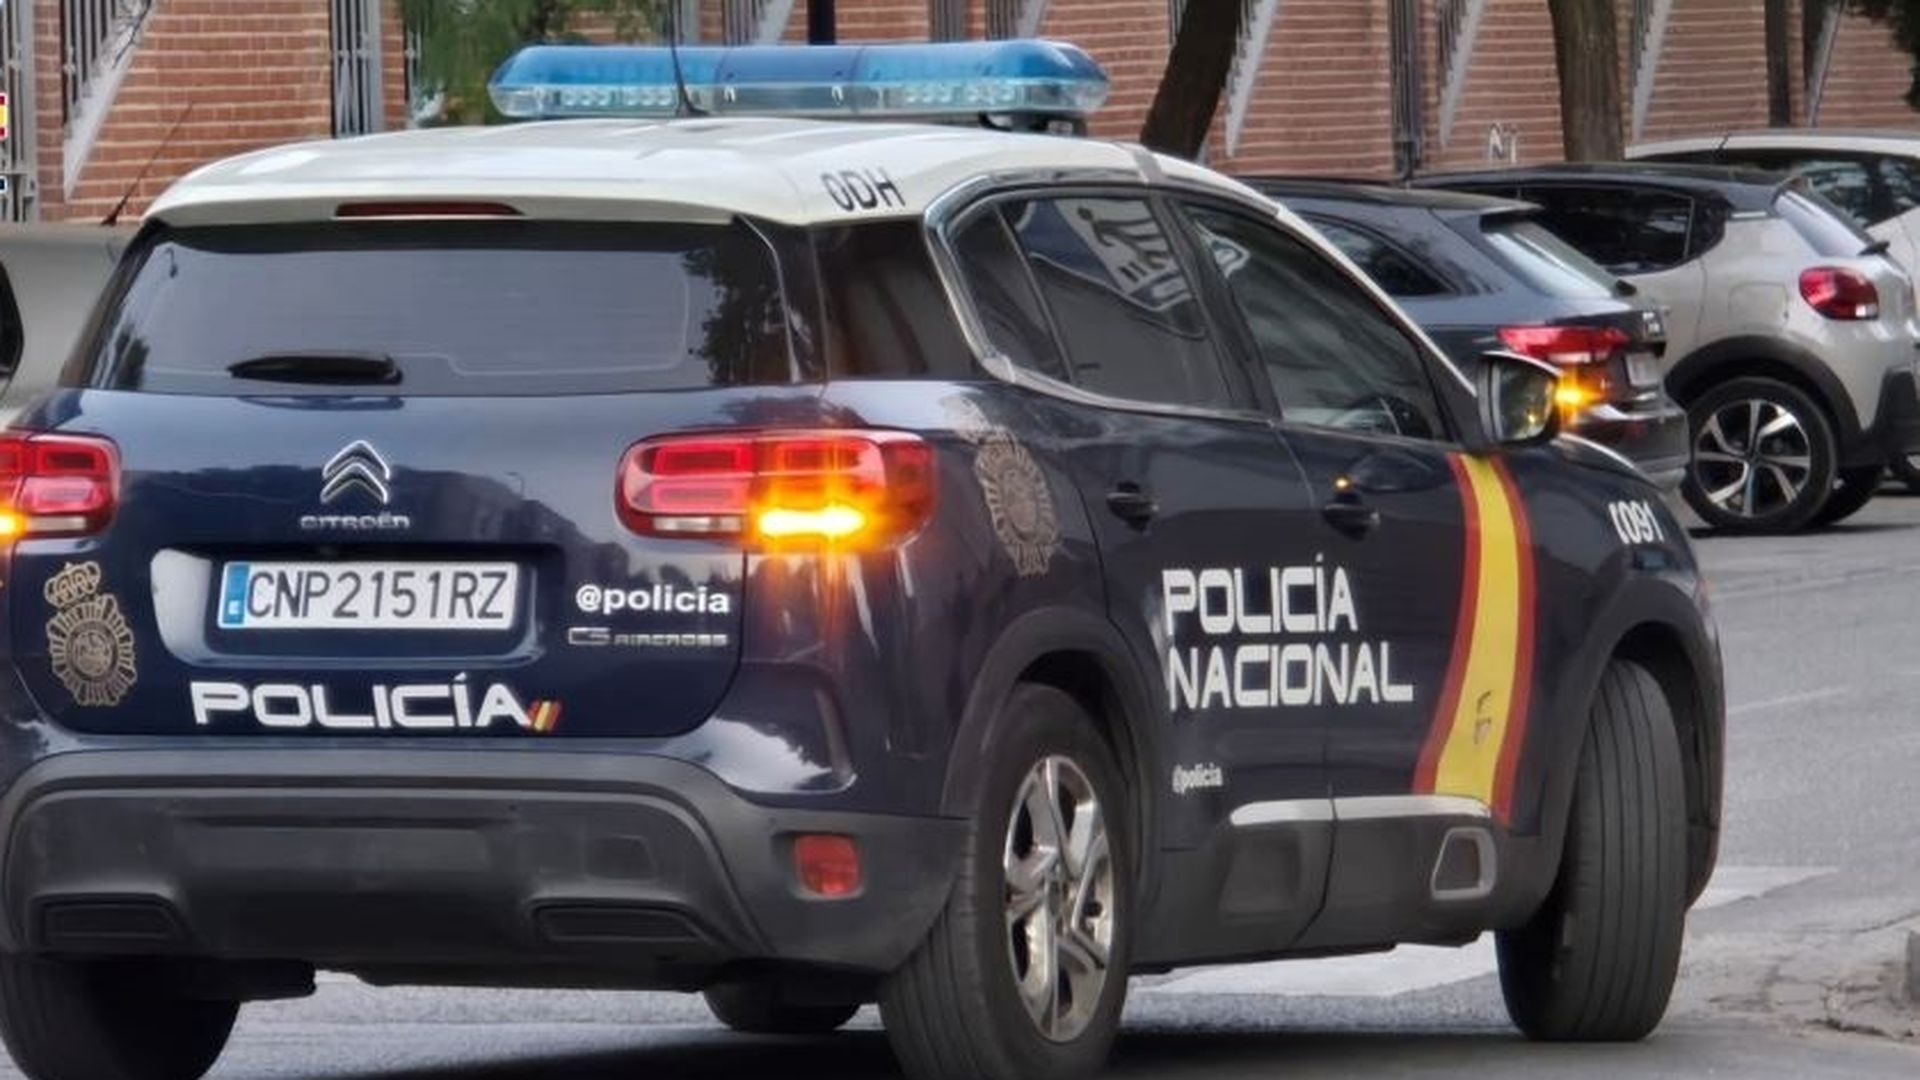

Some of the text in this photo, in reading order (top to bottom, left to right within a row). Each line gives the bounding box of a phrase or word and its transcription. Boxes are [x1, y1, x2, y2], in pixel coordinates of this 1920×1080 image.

[576, 584, 730, 615] @policia
[1163, 553, 1358, 635] POLICÍA
[190, 672, 532, 728] POLICÍA
[1168, 642, 1413, 711] NACIONAL
